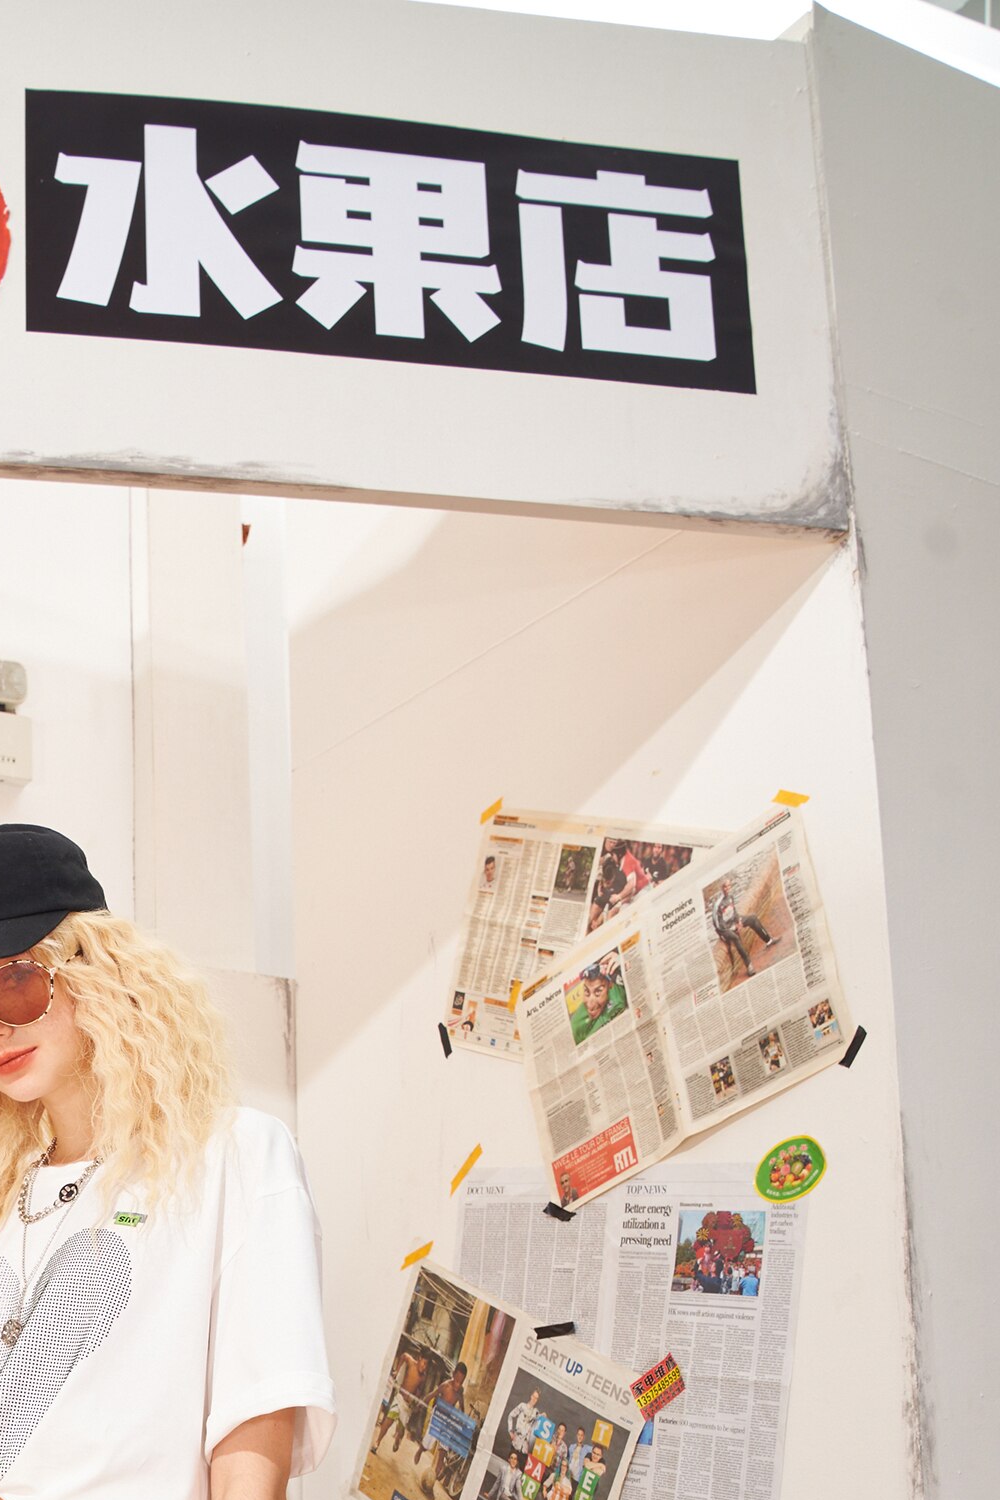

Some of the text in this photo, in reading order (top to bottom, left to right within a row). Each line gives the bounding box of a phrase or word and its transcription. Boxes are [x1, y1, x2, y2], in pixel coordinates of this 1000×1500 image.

[54, 123, 718, 362] 水果店
[613, 1146, 637, 1173] RTL
[467, 1185, 505, 1195] DOCUMENT
[626, 1184, 668, 1194] TOP NEWS
[624, 1202, 672, 1217] Better energy
[622, 1217, 659, 1230] utilization
[620, 1233, 672, 1248] pressing need
[523, 1336, 583, 1377] STARTUP
[585, 1369, 632, 1407] TEENS
